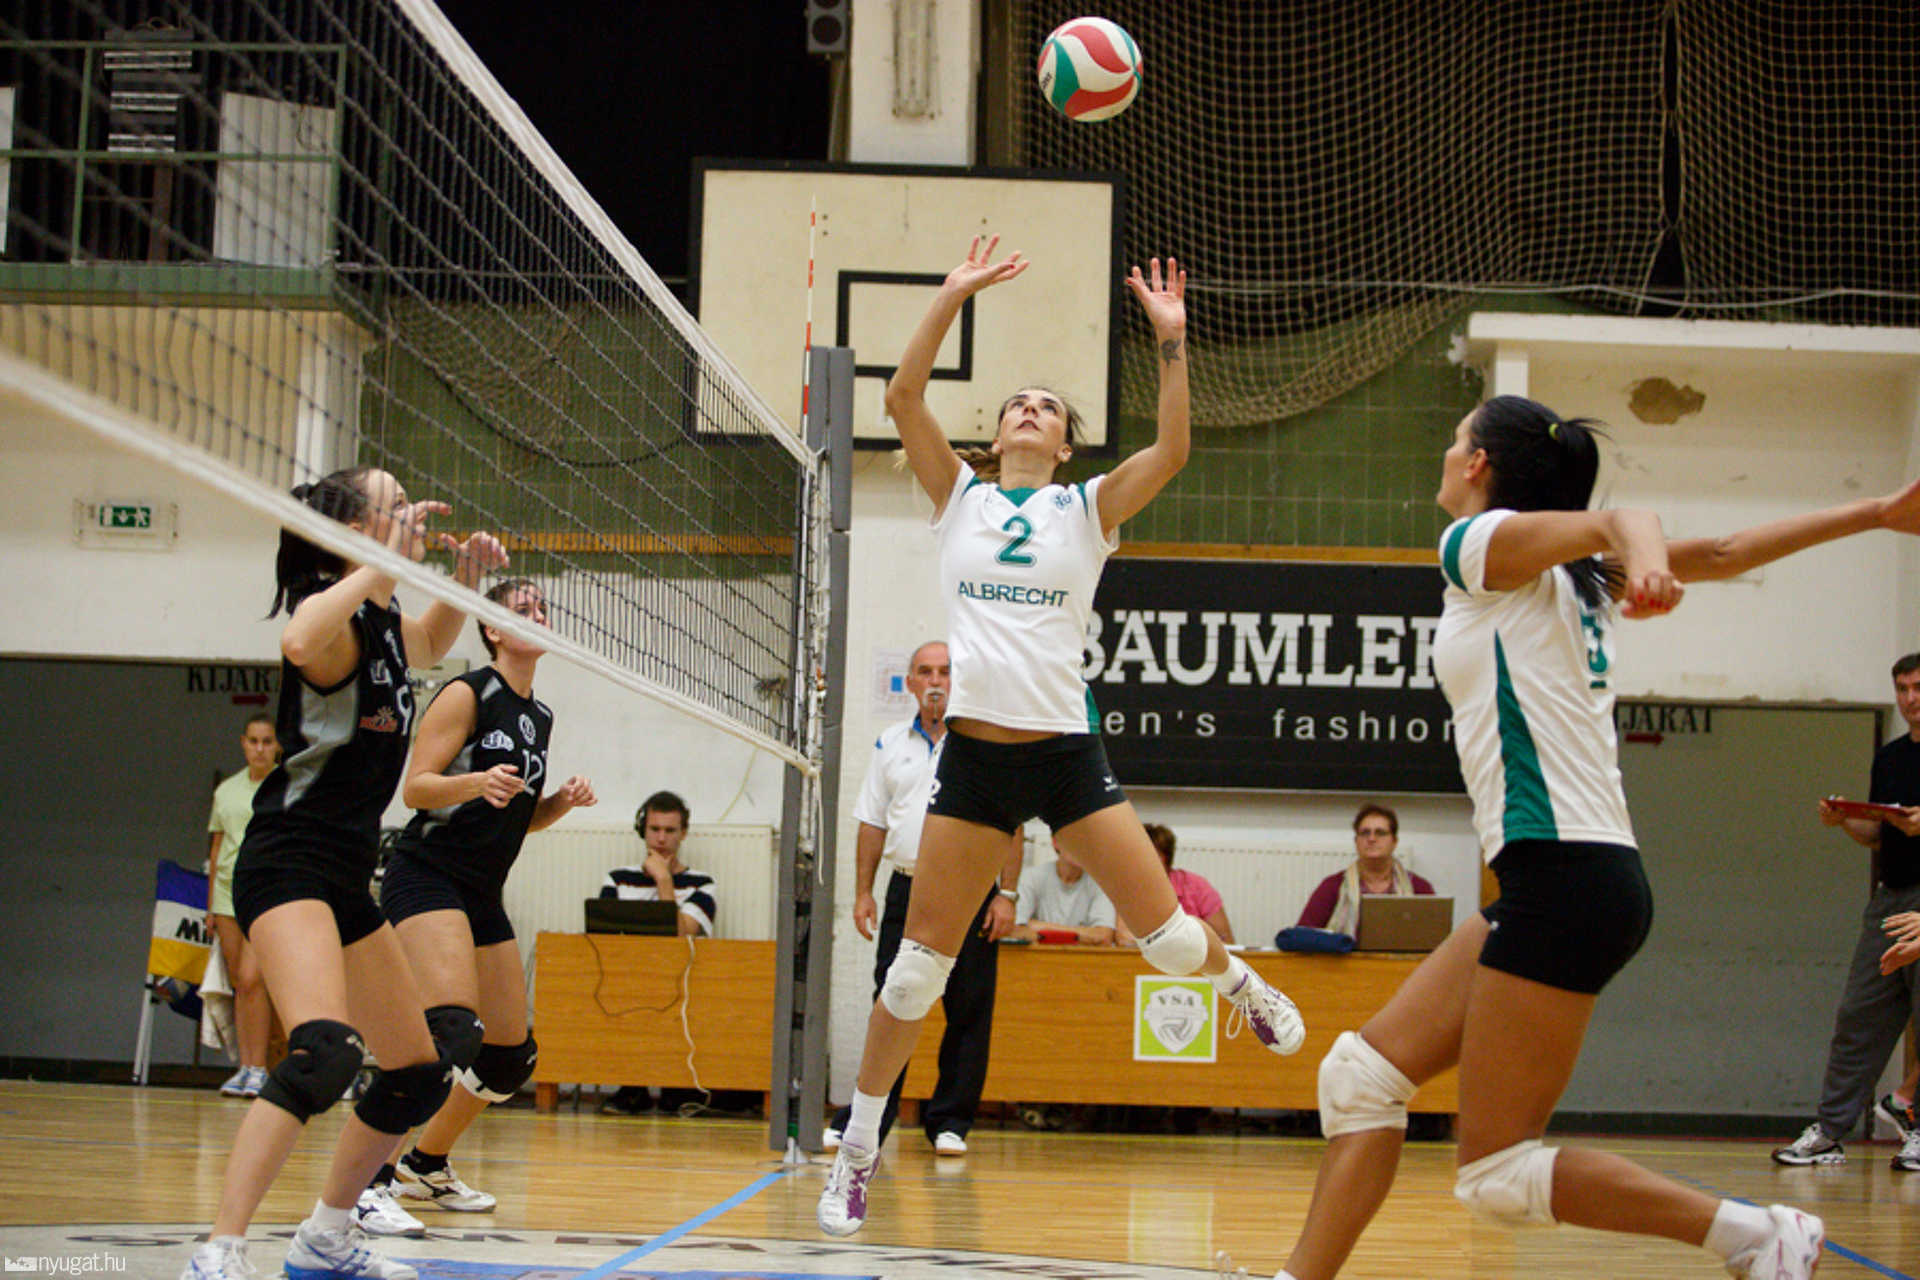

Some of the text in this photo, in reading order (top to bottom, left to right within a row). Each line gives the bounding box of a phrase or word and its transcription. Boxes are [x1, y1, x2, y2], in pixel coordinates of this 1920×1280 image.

[995, 513, 1037, 568] 2
[957, 580, 1070, 608] ALBRECHT
[1103, 709, 1217, 738] en's
